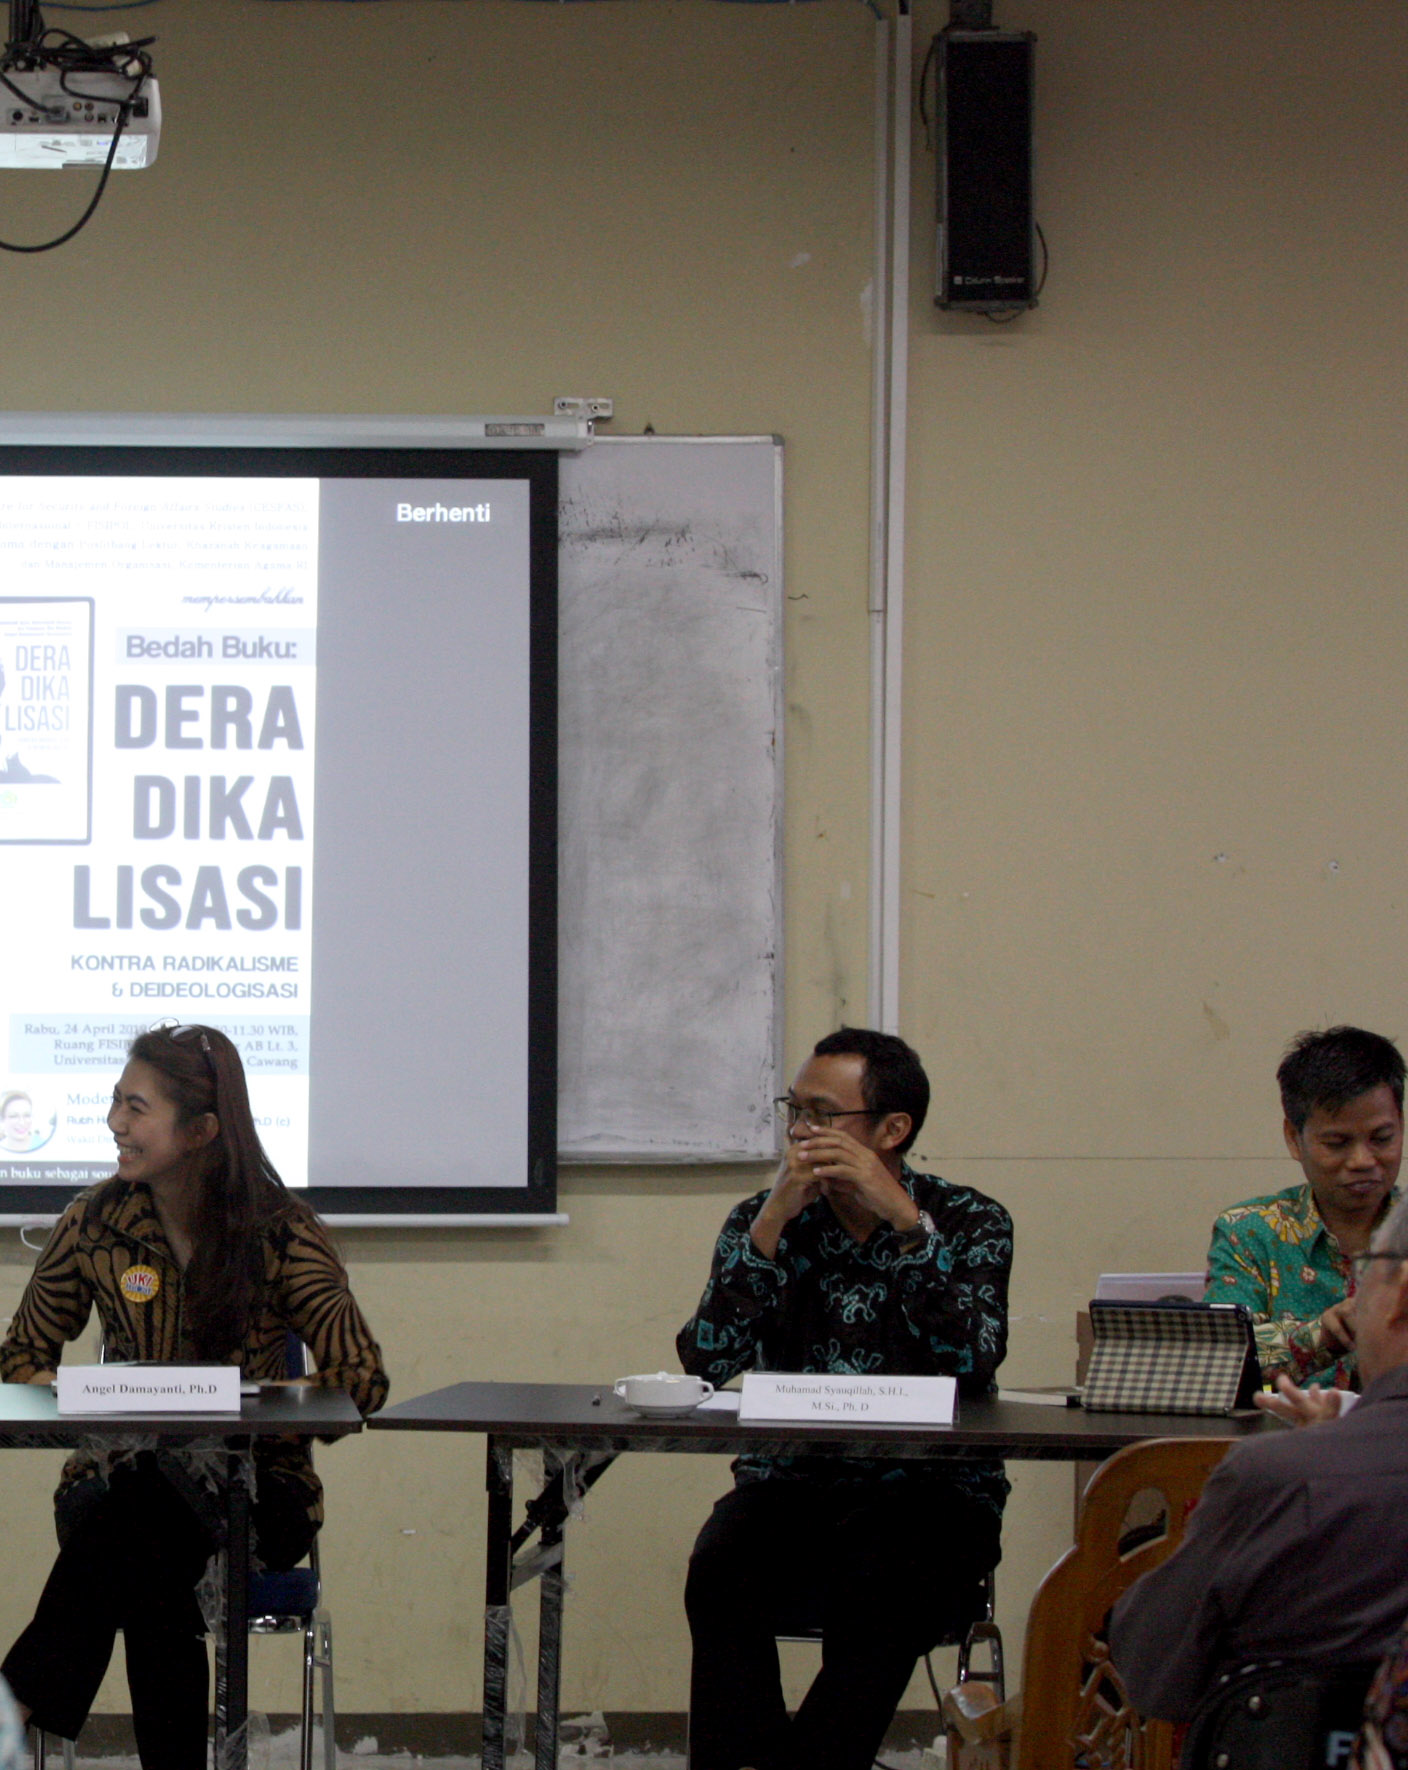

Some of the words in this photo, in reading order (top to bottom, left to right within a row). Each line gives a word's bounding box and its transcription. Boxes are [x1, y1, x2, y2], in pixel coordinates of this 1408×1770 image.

[396, 502, 491, 522] Berhenti
[125, 634, 213, 659] Bedah
[221, 634, 298, 659] Buku:
[15, 644, 71, 671] DERA
[21, 675, 70, 701] DIKA
[4, 704, 70, 731] LISASI
[115, 684, 305, 750] DERA
[133, 774, 305, 840] DIKA
[72, 864, 303, 931] LISASI
[71, 954, 156, 971] KONTRA
[162, 955, 300, 972] RADIKALISME
[111, 982, 123, 998] &
[129, 982, 299, 999] DEIDEOLOGISASI
[24, 1023, 60, 1036] Rabu,
[63, 1024, 78, 1035] 24
[82, 1023, 115, 1038] April
[267, 1024, 299, 1037] WIB,
[53, 1039, 95, 1053] Ruang
[244, 1041, 263, 1052] AB
[53, 1054, 128, 1066] Universitas
[246, 1055, 299, 1070] Cawang
[11, 1166, 41, 1180] buku
[44, 1166, 89, 1182] sebagai
[127, 1273, 153, 1287] UKI
[82, 1383, 116, 1395] Angel
[119, 1383, 186, 1396] Damayanti,
[189, 1384, 218, 1395] Ph.D
[775, 1383, 822, 1395] Muhamad
